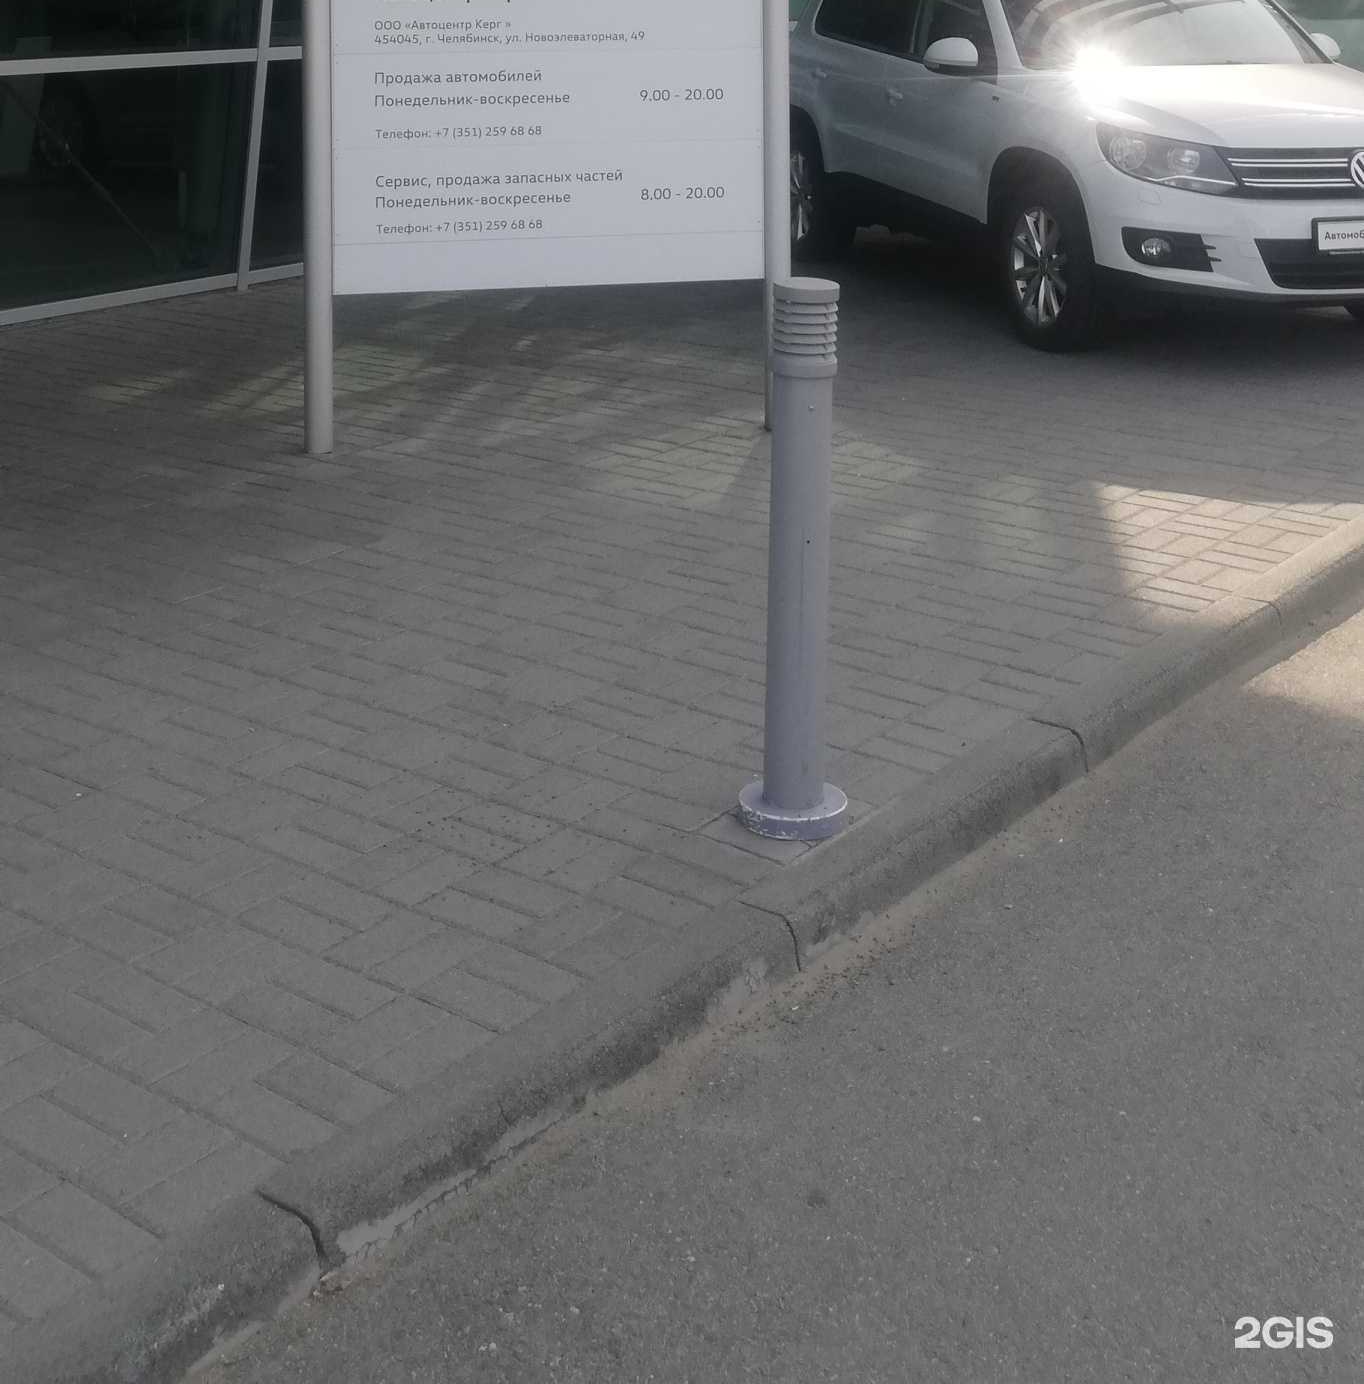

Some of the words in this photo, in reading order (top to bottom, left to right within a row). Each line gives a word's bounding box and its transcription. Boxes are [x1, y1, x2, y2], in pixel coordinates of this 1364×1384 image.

[374, 20, 402, 31] ООО
[404, 18, 472, 32] «Автоцентр
[475, 18, 503, 30] Керг
[374, 33, 422, 46] 454045,
[425, 35, 436, 44] г.
[437, 32, 503, 45] Челябинск,
[505, 33, 522, 46] ул.
[525, 30, 628, 43] Новоэлеваторная,
[630, 30, 646, 41] 49
[374, 71, 442, 87] Продажа
[445, 68, 543, 83] автомобилей
[374, 92, 571, 108] Понедельник-воскресенье
[639, 88, 672, 102] 9.00
[684, 87, 725, 101] 20.00
[375, 128, 432, 140] Телефон:
[434, 127, 450, 137] +7
[452, 126, 482, 140] (351)
[485, 125, 507, 137] 259
[510, 125, 525, 136] 68
[527, 125, 542, 136] 68
[375, 175, 431, 190] Сервис,
[435, 174, 501, 188] продажа
[504, 171, 572, 185] запасных
[575, 168, 623, 184] частей
[685, 186, 726, 200] 20.00
[375, 194, 571, 209] Понедельник-воскресенье
[376, 223, 433, 236] Телефон:
[435, 222, 451, 233] +7
[453, 221, 483, 235] (351)
[486, 220, 508, 232] 259
[511, 219, 526, 231] 68
[528, 219, 543, 230] 68
